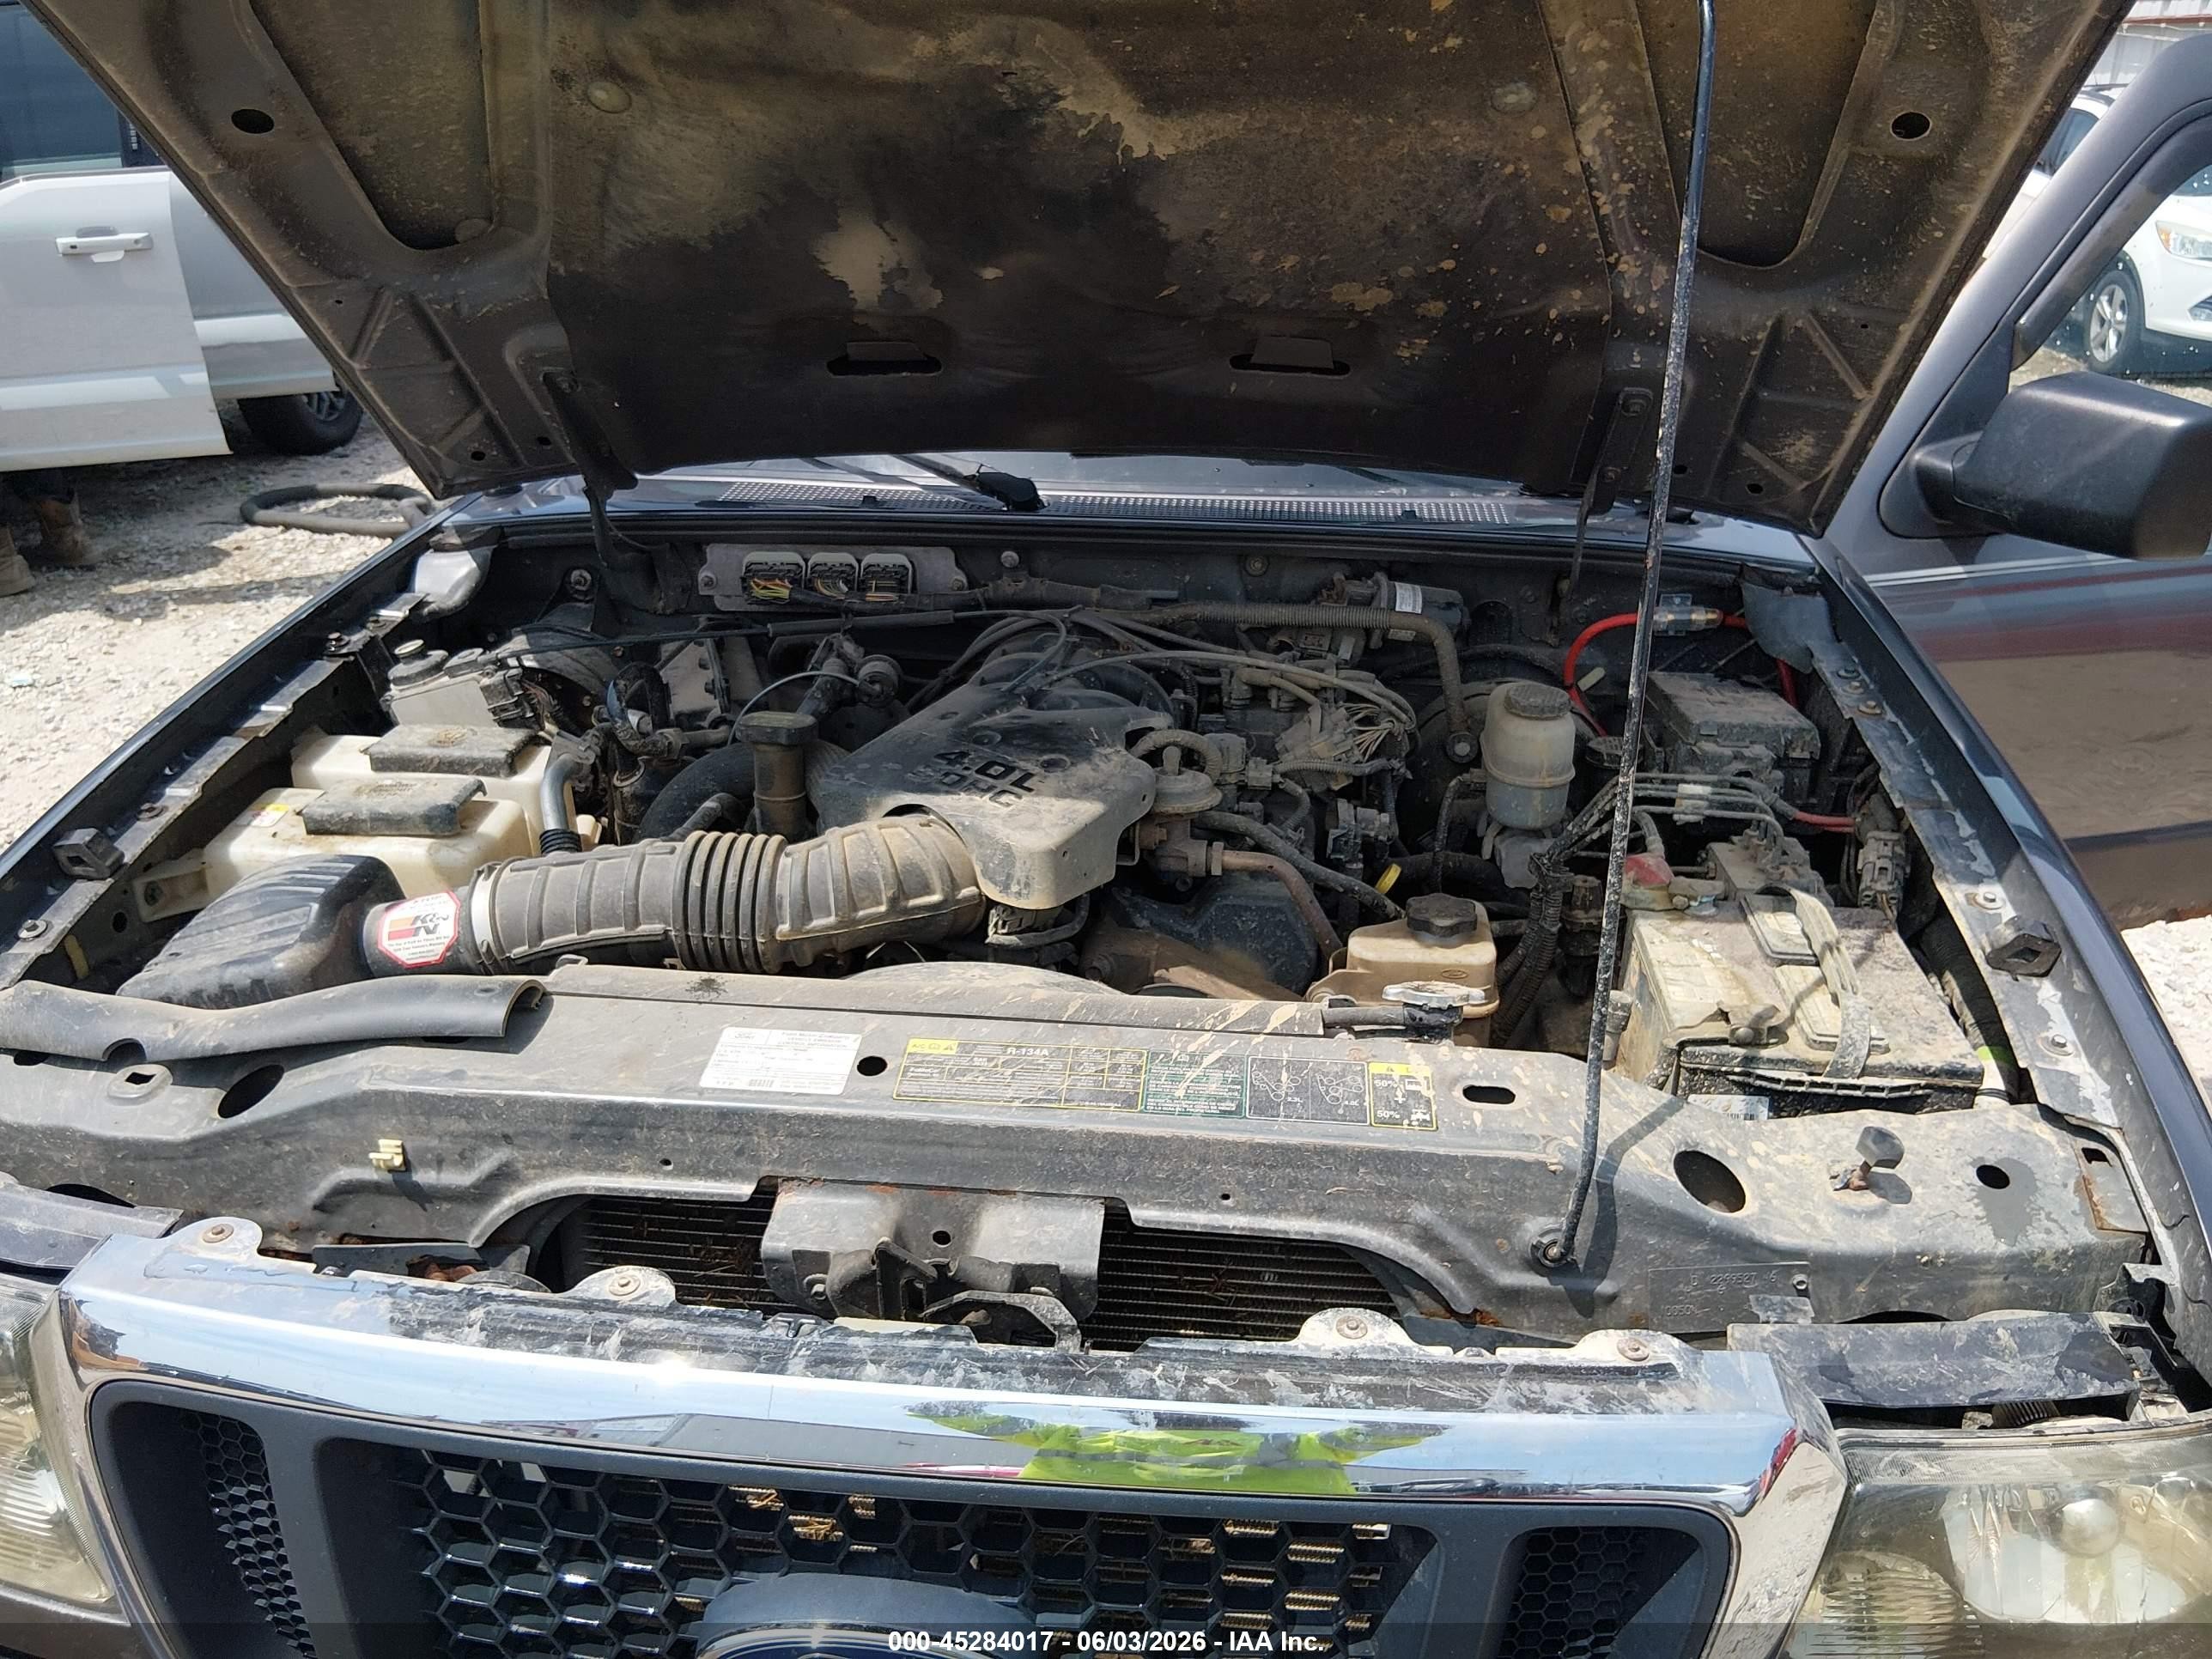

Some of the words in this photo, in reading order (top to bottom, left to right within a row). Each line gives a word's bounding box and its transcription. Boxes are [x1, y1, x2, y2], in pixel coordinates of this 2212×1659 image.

[933, 750, 1035, 793] 4.0L
[1006, 1046, 1049, 1056] R-134A
[1374, 1079, 1398, 1088] 50%
[1376, 1109, 1401, 1119] 50%
